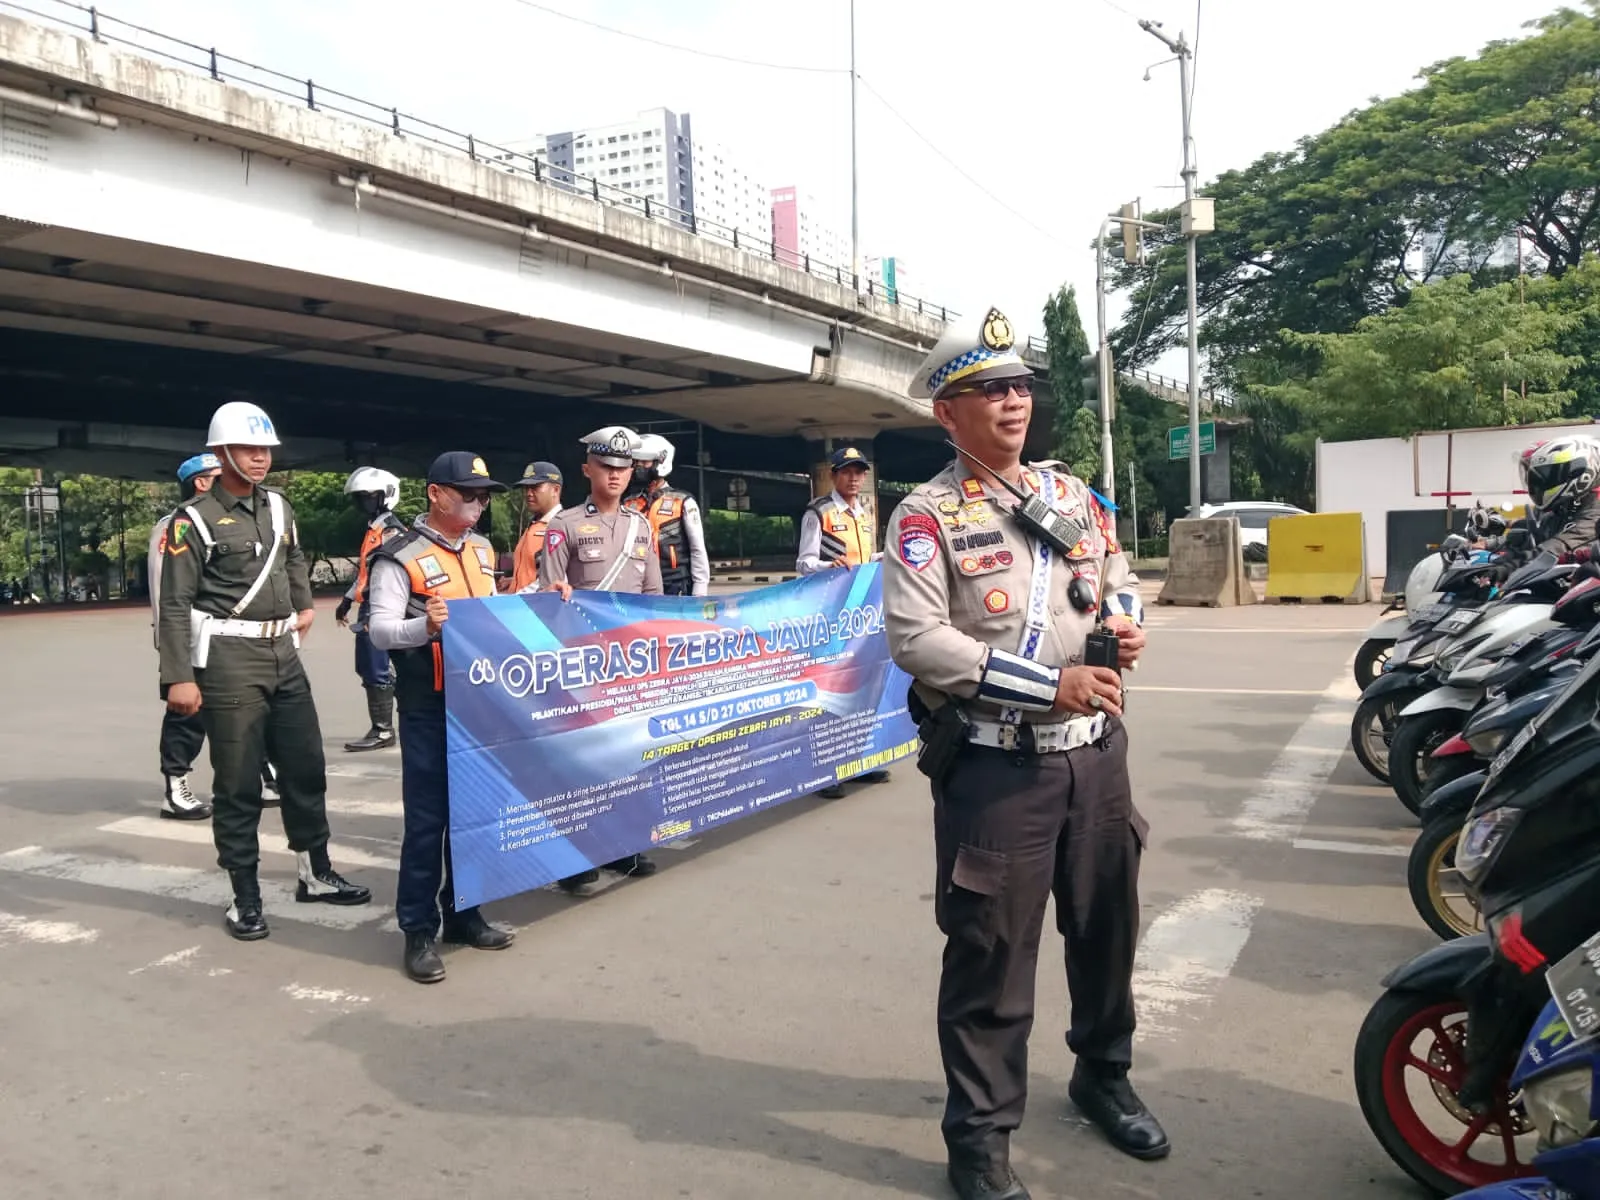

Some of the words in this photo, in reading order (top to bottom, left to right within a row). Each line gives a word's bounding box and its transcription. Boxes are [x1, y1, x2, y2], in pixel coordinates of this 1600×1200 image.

[247, 416, 273, 434] PM
[578, 536, 604, 546] DICKY
[666, 625, 761, 672] ZEBRA
[660, 717, 682, 734] TGL
[683, 714, 697, 728] 14
[699, 708, 719, 724] S/D
[721, 704, 735, 719] 27
[736, 693, 781, 715] OKTOBER
[783, 687, 808, 705] 2024
[657, 740, 696, 757] TARGET
[697, 731, 737, 748] OPERASI
[738, 721, 767, 737] ZEBRA
[769, 715, 792, 729] JAYA
[799, 707, 823, 720] 2024
[499, 807, 505, 817] 1.
[506, 799, 543, 815] Memasang
[499, 819, 505, 829] 2.
[500, 831, 506, 841] 3.
[507, 822, 547, 839] Pengemudi
[507, 834, 545, 851] Kendaraan
